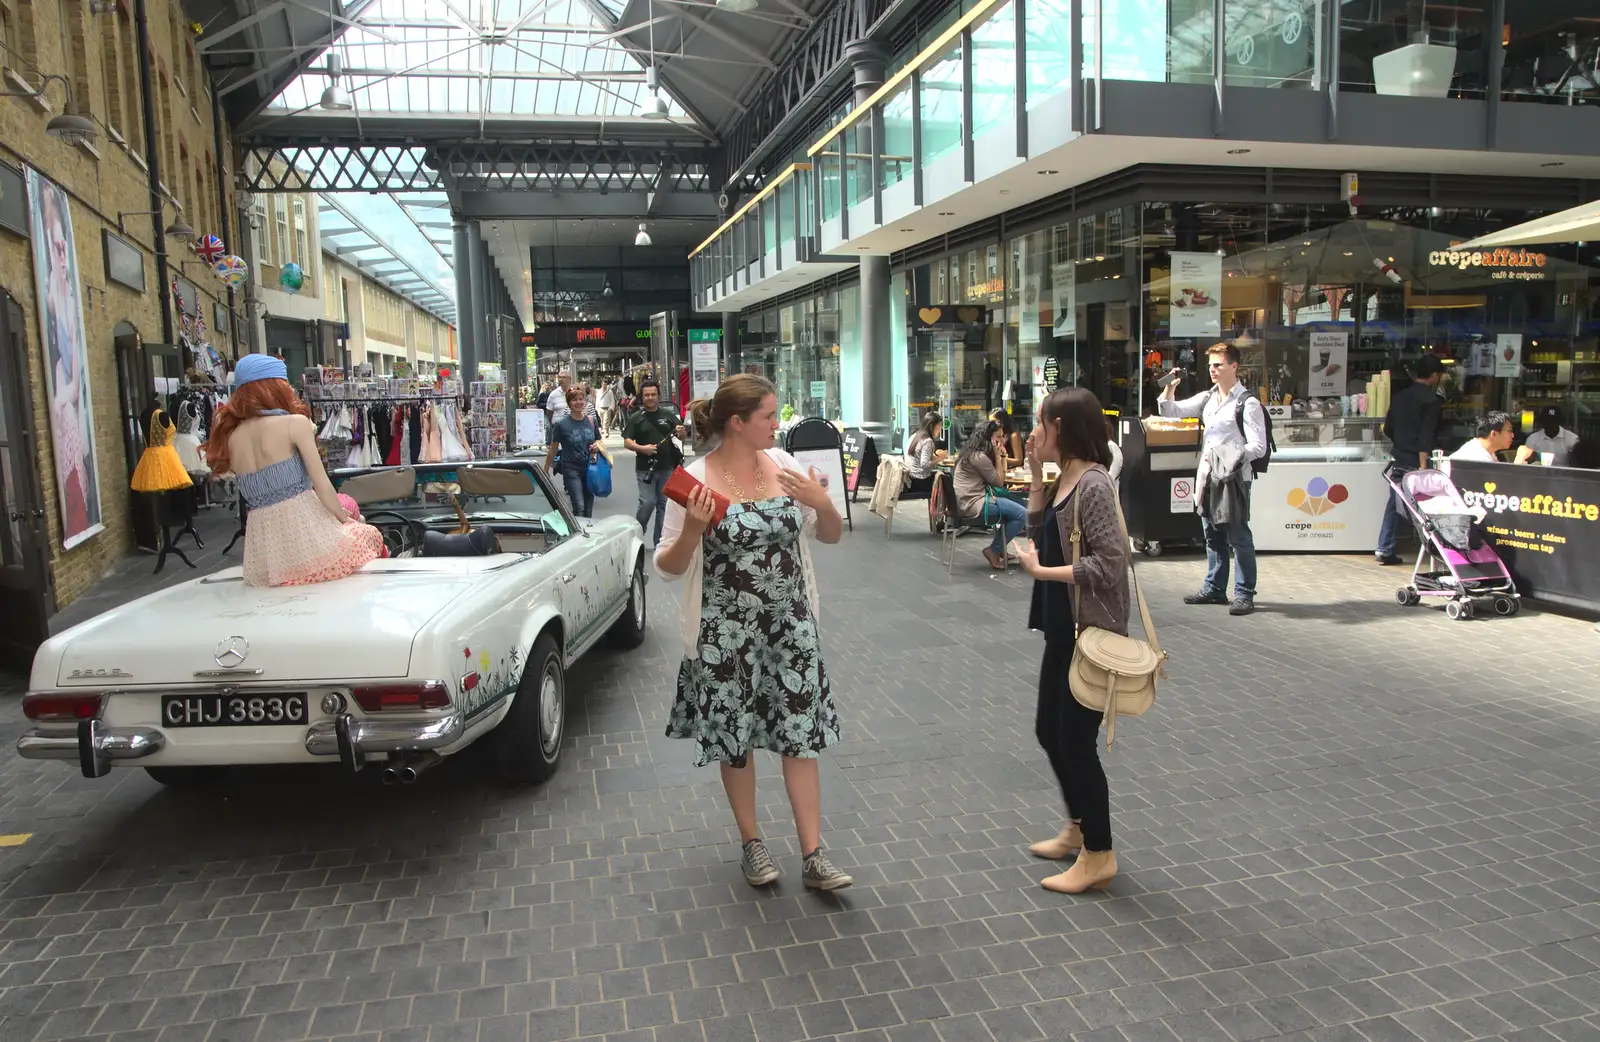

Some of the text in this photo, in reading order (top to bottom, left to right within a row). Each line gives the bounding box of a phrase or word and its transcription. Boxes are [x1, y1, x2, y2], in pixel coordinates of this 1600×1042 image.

[576, 328, 607, 343] giraffe
[1487, 525, 1508, 535] wines
[1514, 529, 1535, 539] beers
[1496, 538, 1555, 554] prosecco on tap
[166, 696, 303, 723] CHJ 383G
